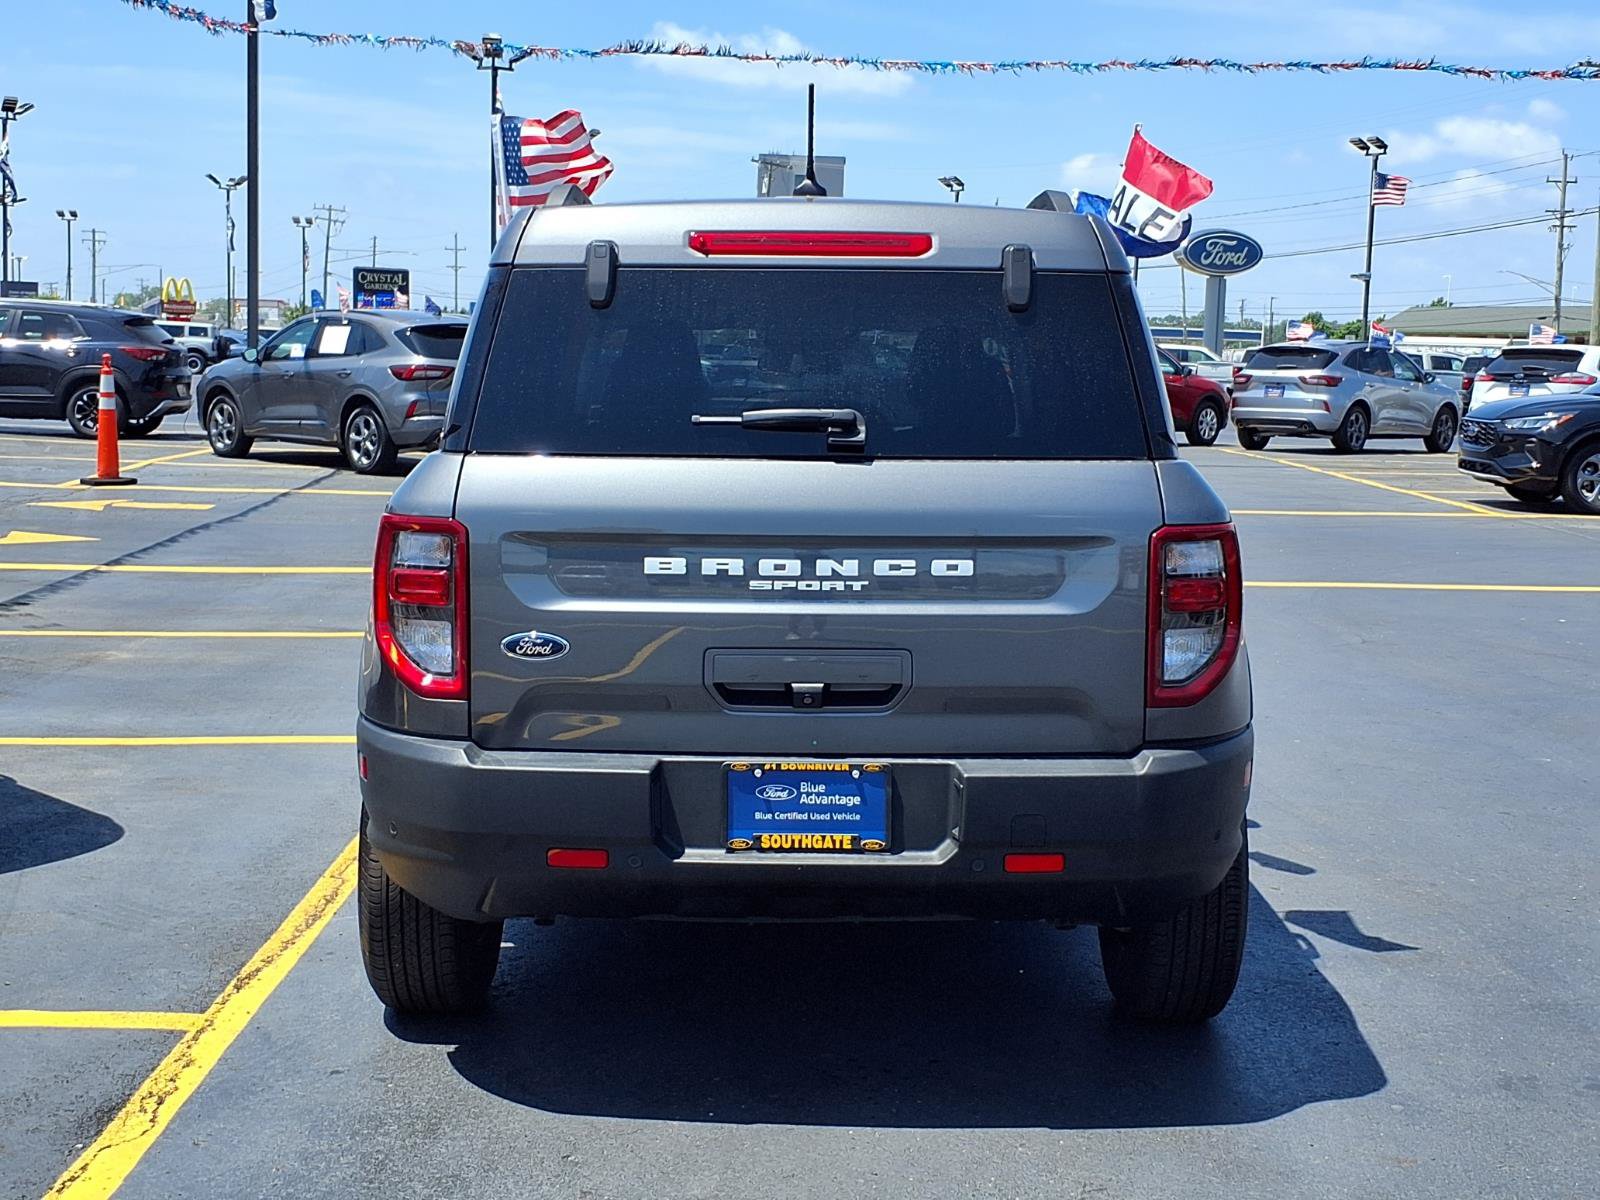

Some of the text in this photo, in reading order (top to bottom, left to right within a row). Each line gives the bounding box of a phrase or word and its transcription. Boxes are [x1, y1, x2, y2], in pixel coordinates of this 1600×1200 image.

[1200, 239, 1249, 266] Ford
[358, 271, 407, 286] CRYSTAL
[643, 557, 975, 577] BRONCO
[749, 580, 869, 591] SPORT
[516, 637, 553, 655] Ford
[780, 762, 850, 771] DOWNRIVER
[763, 786, 789, 798] Ford
[800, 782, 826, 793] Blue
[800, 794, 861, 807] Advantage
[754, 811, 861, 821] Blue Certified Used Vehicle
[761, 834, 852, 849] SOUTHGATE
